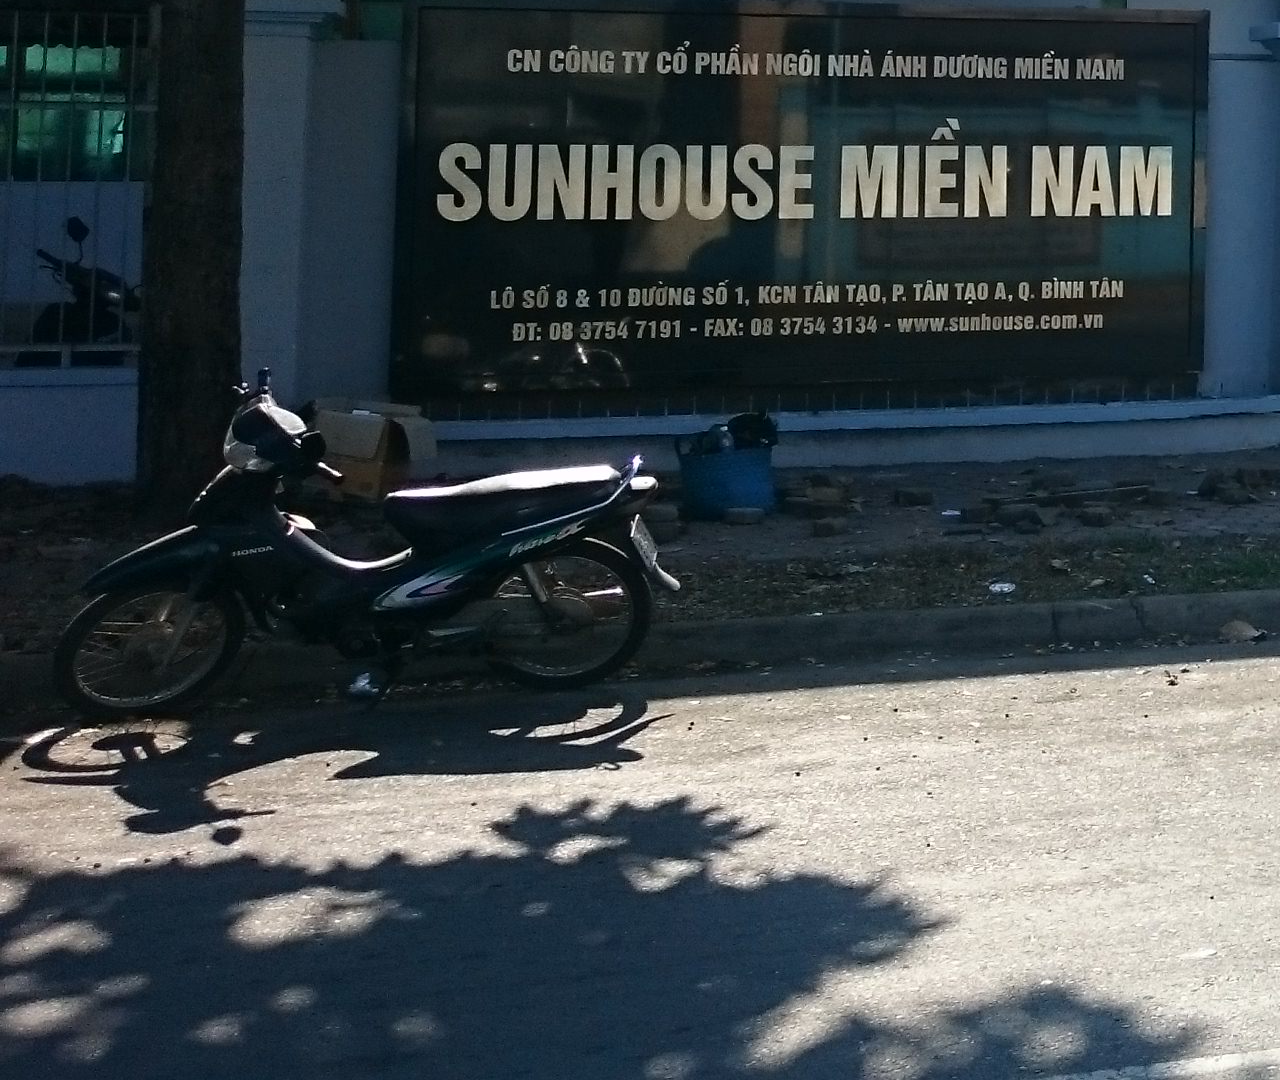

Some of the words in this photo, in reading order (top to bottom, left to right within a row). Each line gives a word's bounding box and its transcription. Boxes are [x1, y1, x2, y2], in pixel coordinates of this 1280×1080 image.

[507, 49, 541, 73] CN
[549, 45, 615, 74] CÔNG
[621, 50, 650, 74] TY
[656, 41, 691, 75] CỔ
[695, 44, 759, 76] PHẦN
[766, 49, 820, 77] NGÔI
[828, 49, 874, 77] NHÀ
[880, 50, 927, 78] ÁNH
[933, 54, 1008, 79] DƯƠNG
[1014, 50, 1069, 80] MIỀN
[1075, 58, 1125, 81] NAM
[436, 142, 815, 221] SUNHOUSE
[840, 117, 1009, 219] MIỀN
[1032, 145, 1173, 219] NAM
[490, 286, 515, 310] LÔ
[522, 283, 551, 309] SỐ
[556, 289, 568, 309] 8
[575, 289, 590, 308] &
[598, 289, 622, 307] 10
[627, 281, 696, 307] ĐƯỜNG
[702, 280, 730, 306] SỐ
[734, 286, 750, 307] 1,
[758, 285, 797, 305] KCN
[803, 281, 840, 304] TÂN
[846, 284, 887, 307] TẠO,
[892, 284, 907, 302] P.
[913, 280, 949, 302] TÂN
[954, 282, 989, 305] TẠO
[994, 282, 1013, 302] A,
[1018, 281, 1035, 302] Q.
[1041, 277, 1084, 300] BÌNH
[1090, 277, 1124, 299] TÂN
[512, 322, 542, 342] ĐT:
[549, 322, 574, 341] 08
[580, 320, 630, 340] 3754
[635, 320, 681, 339] 7191
[704, 318, 744, 337] FAX:
[750, 317, 773, 336] 08
[780, 315, 826, 336] 3754
[832, 315, 878, 335] 3134
[897, 312, 1104, 334] www.sunhouse.com.vn
[232, 545, 275, 558] HONDA
